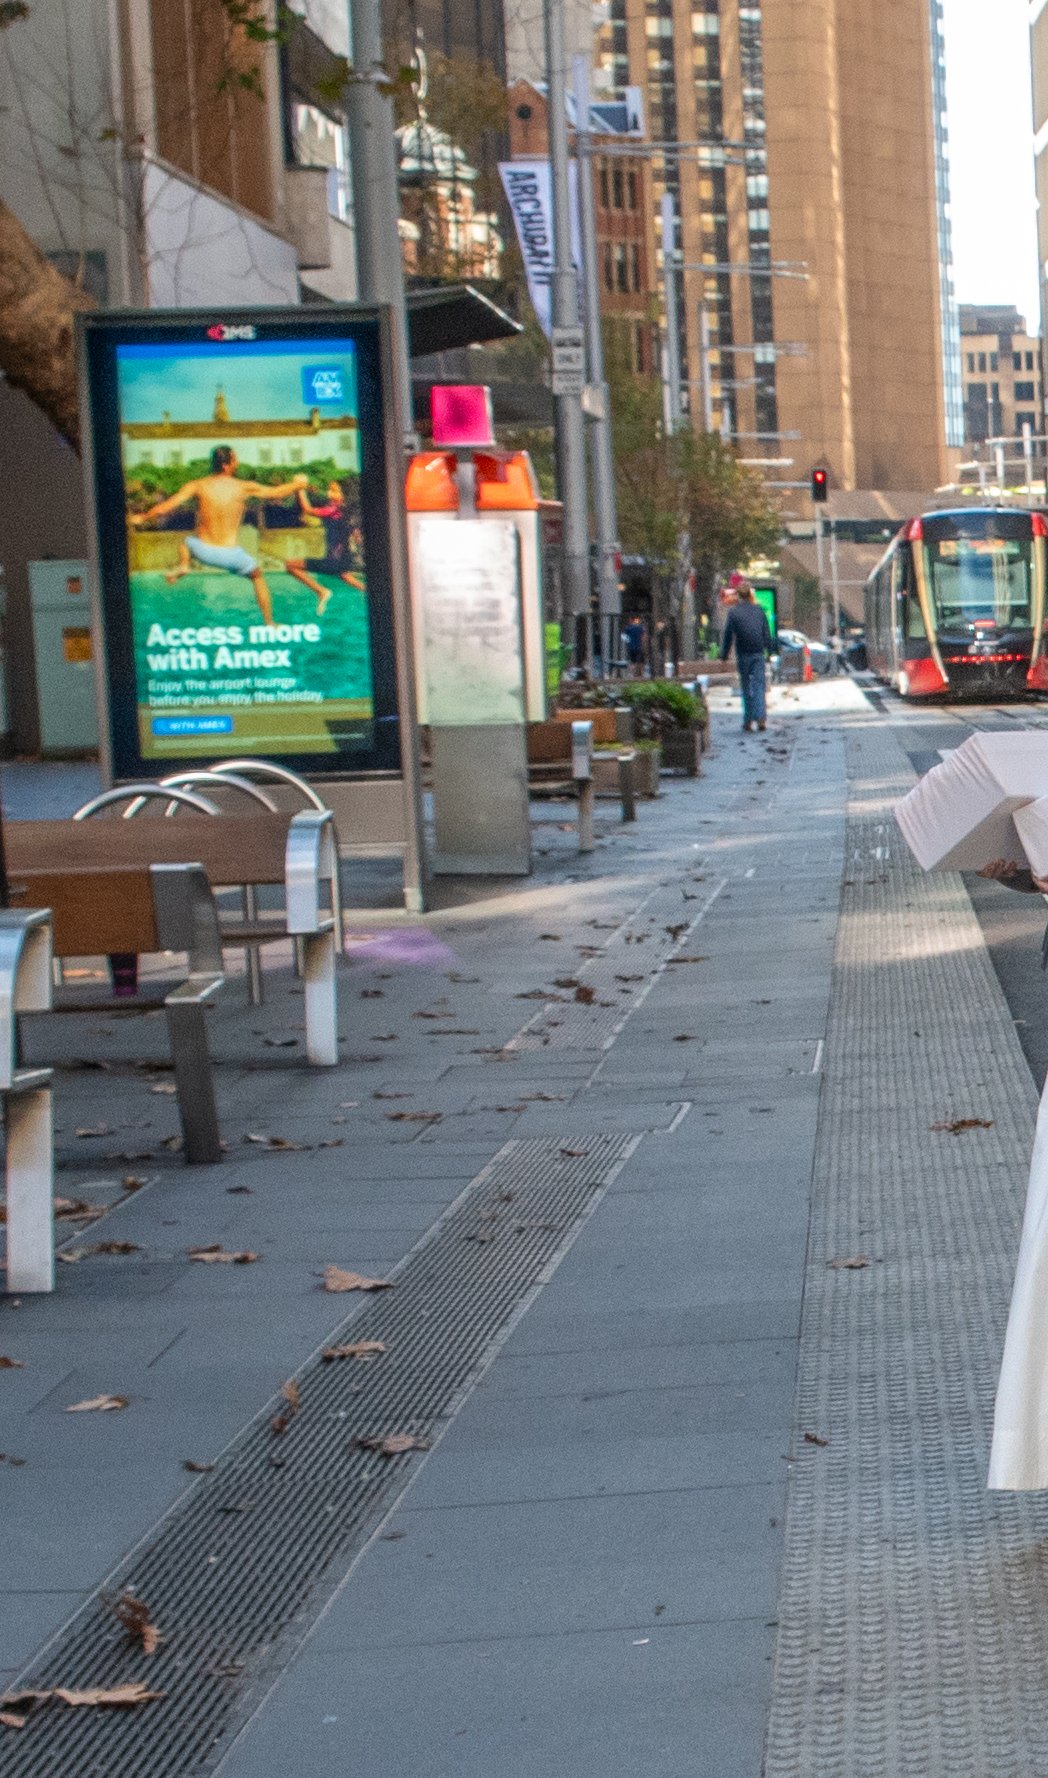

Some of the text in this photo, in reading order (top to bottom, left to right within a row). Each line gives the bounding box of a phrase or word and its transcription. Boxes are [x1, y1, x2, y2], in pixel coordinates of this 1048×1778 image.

[146, 623, 321, 647] Access more
[146, 646, 292, 671] with Amex
[148, 676, 297, 693] Enjoy the airport lounge
[148, 694, 191, 706] before
[191, 696, 216, 708] you
[218, 693, 251, 705] enjoy
[253, 691, 276, 703] the
